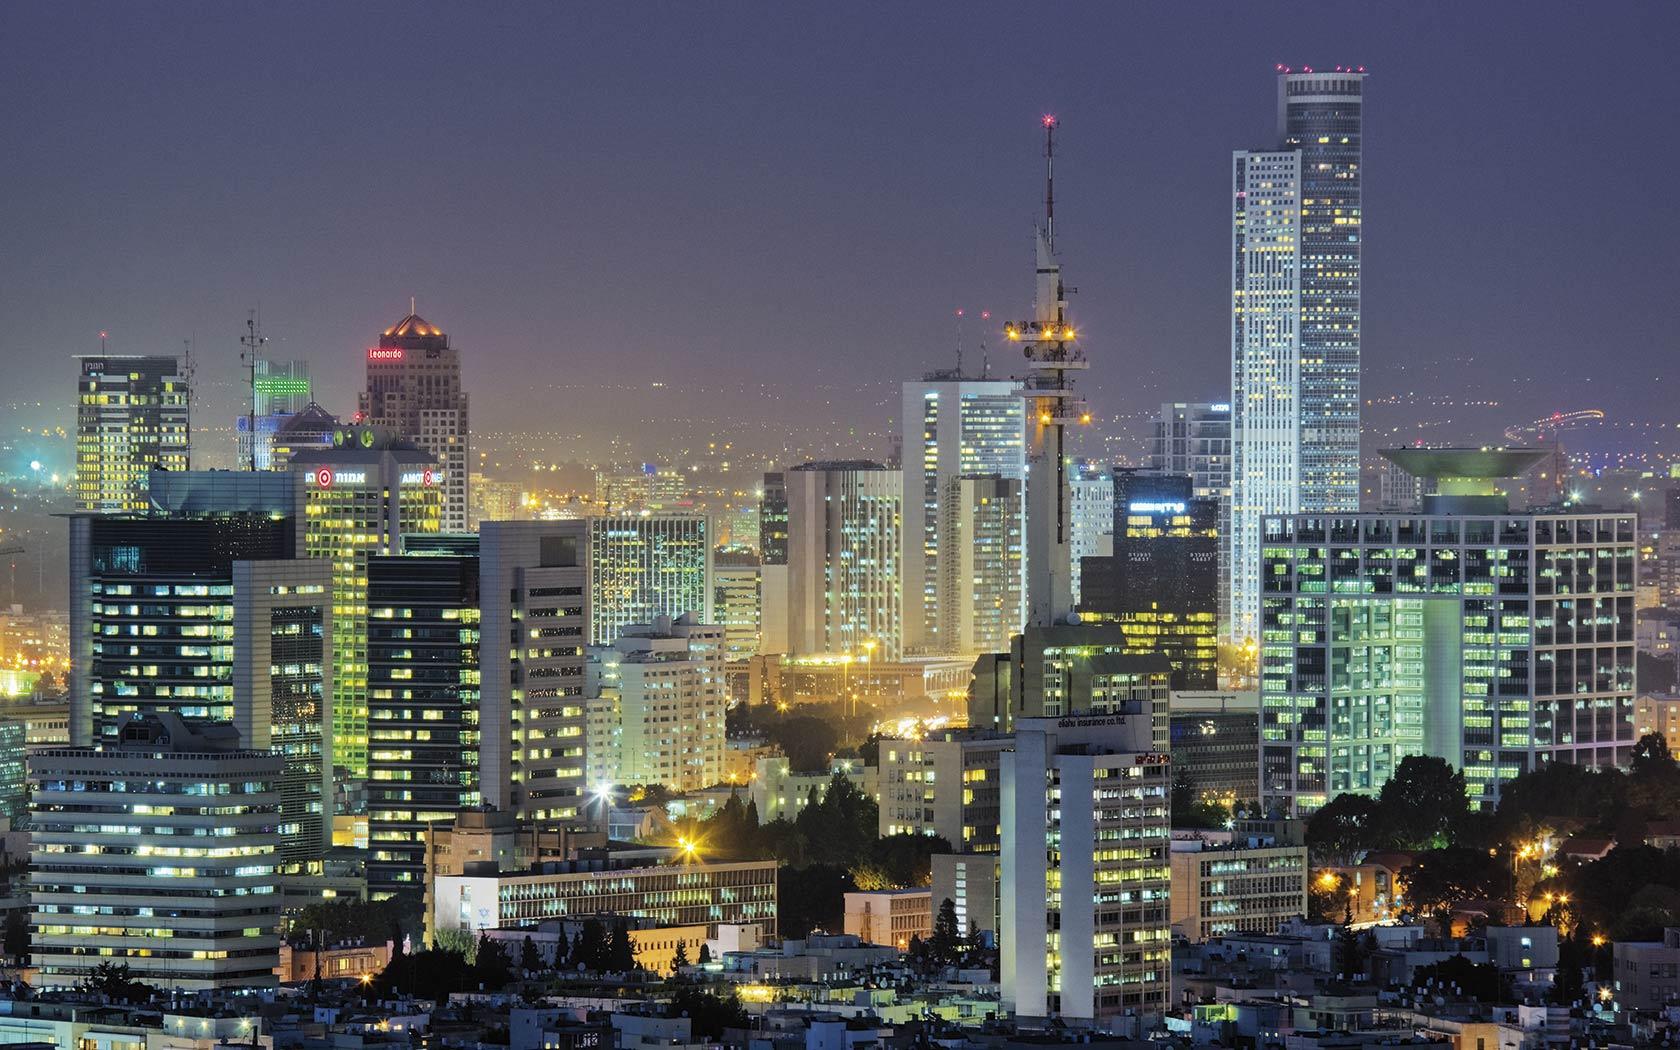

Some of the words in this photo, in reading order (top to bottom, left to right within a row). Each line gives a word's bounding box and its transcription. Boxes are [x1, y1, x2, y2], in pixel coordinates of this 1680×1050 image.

[369, 349, 402, 359] Leonardo
[335, 472, 366, 483] אמות
[402, 473, 424, 483] AMOT
[1057, 718, 1076, 728] eliahu
[1077, 718, 1106, 727] insurance
